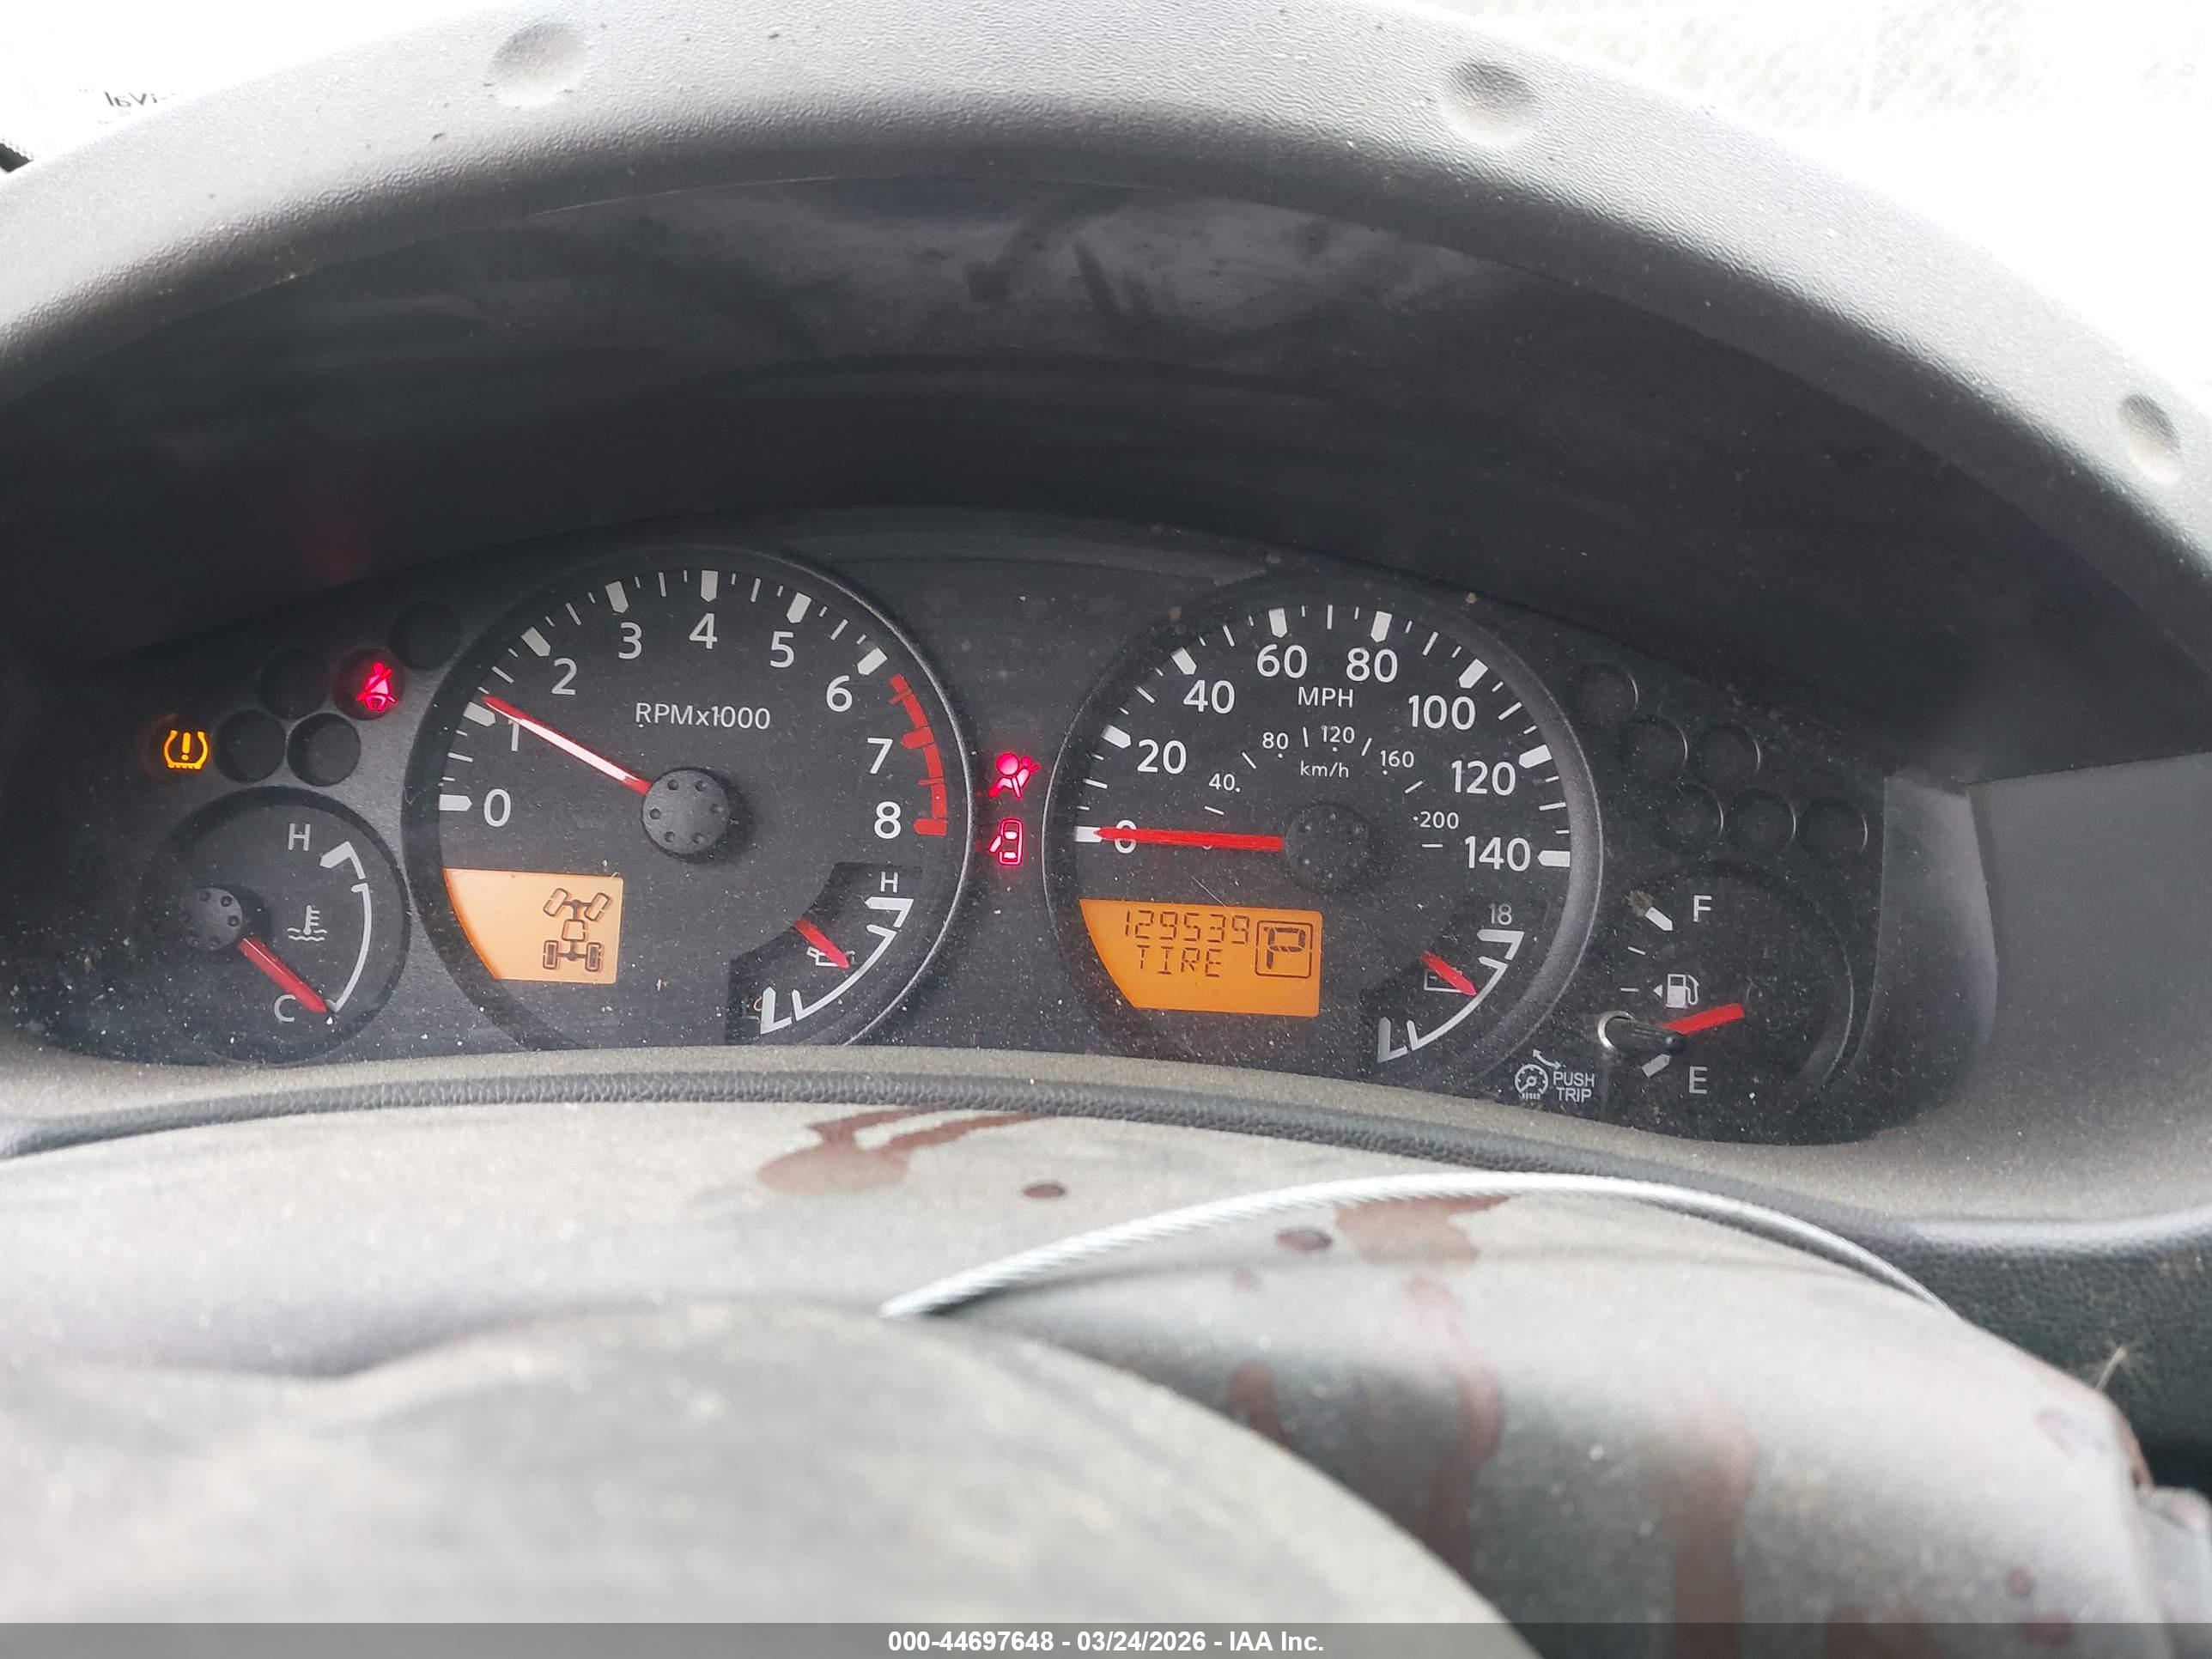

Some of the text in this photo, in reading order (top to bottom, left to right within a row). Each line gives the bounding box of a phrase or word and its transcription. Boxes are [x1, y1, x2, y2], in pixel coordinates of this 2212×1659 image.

[618, 622, 642, 659] 3
[689, 613, 718, 649] 4
[769, 630, 794, 668] 5
[1256, 643, 1308, 678] 60
[1346, 647, 1398, 683] 80
[551, 658, 577, 696] 2
[826, 675, 853, 713] 6
[1182, 679, 1235, 714] 40
[1297, 686, 1353, 708] MPH
[1408, 695, 1476, 730] 100
[635, 702, 770, 728] RPMx1000
[1262, 732, 1289, 750] 80
[1323, 726, 1355, 744] 120
[867, 738, 893, 775] 7
[1137, 738, 1187, 775] 20
[1300, 760, 1349, 778] km/h
[1380, 750, 1414, 768] 160
[1208, 773, 1233, 791] 40
[1451, 760, 1516, 796] 120
[483, 788, 512, 827] 0
[874, 801, 902, 840] 8
[1419, 811, 1459, 830] 200
[288, 823, 311, 852] H
[1465, 836, 1531, 872] 140
[880, 872, 898, 893] H
[1492, 905, 1511, 925] 18
[1693, 895, 1712, 922] F
[1125, 909, 1250, 945] 129539
[1136, 944, 1222, 978] TIRE
[1263, 927, 1306, 970] P
[273, 994, 296, 1023] C
[1553, 1071, 1595, 1087] PUSH
[1556, 1086, 1592, 1103] TRIP
[1688, 1066, 1708, 1095] E
